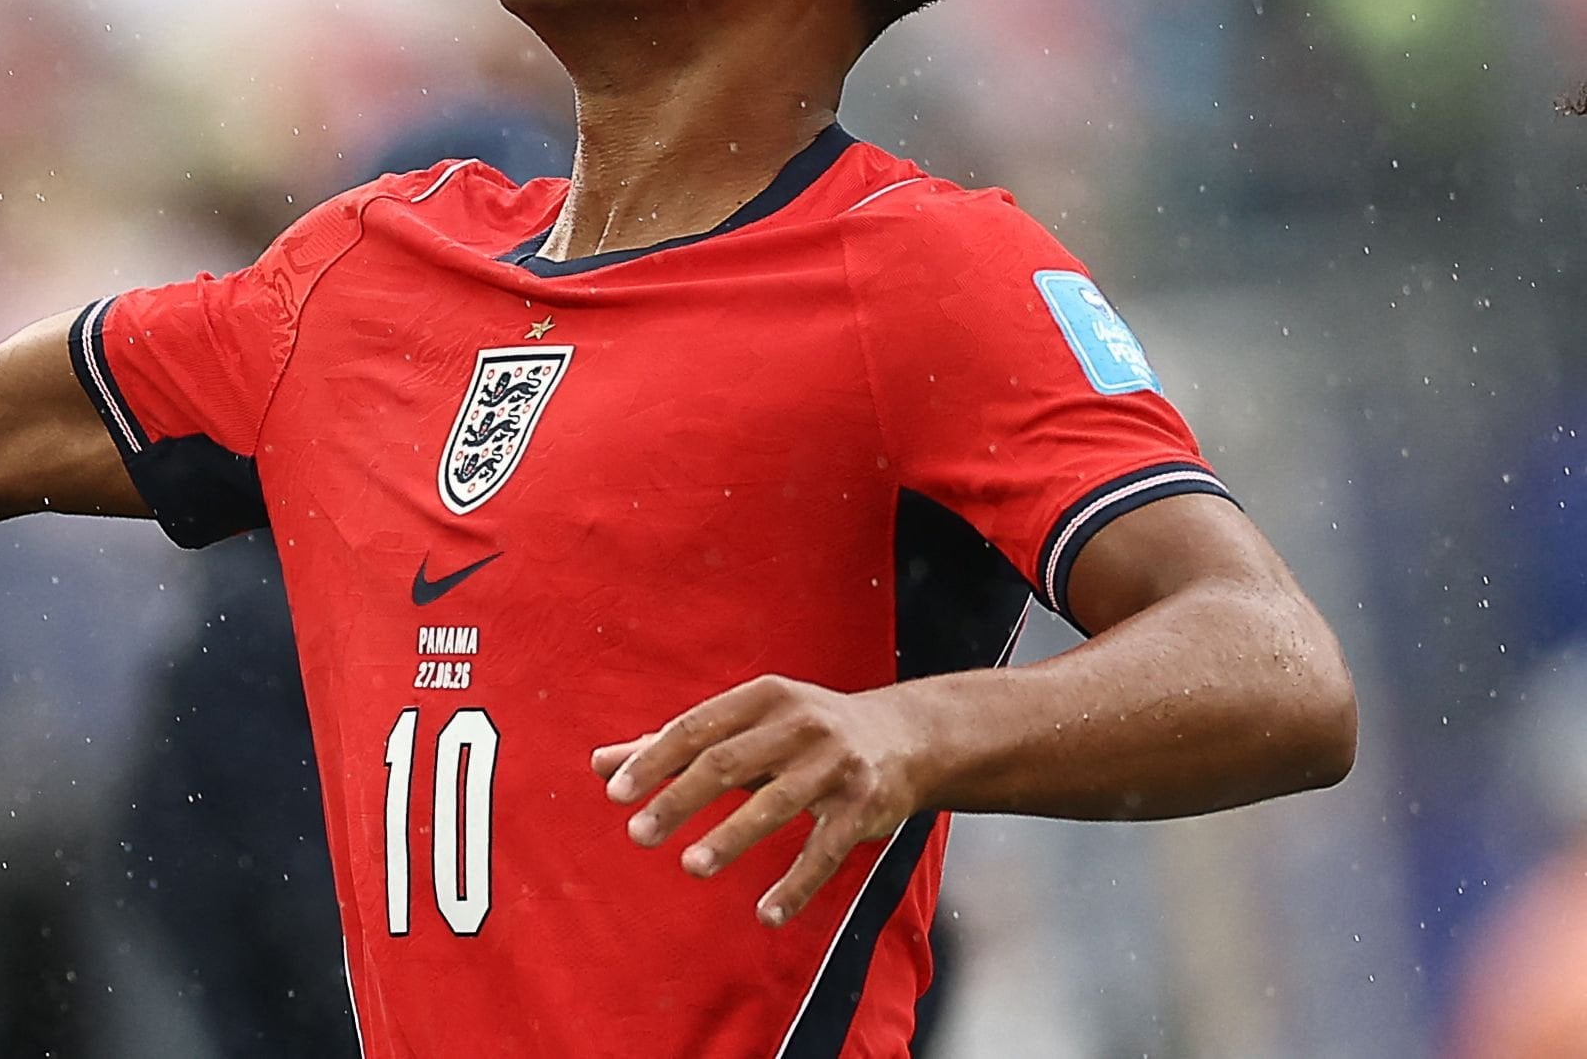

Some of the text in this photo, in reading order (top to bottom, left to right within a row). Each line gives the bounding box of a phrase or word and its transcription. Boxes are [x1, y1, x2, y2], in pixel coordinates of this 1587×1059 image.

[418, 626, 479, 654] PANAMA
[413, 661, 471, 689] 27.06.26
[384, 707, 500, 937] 10
